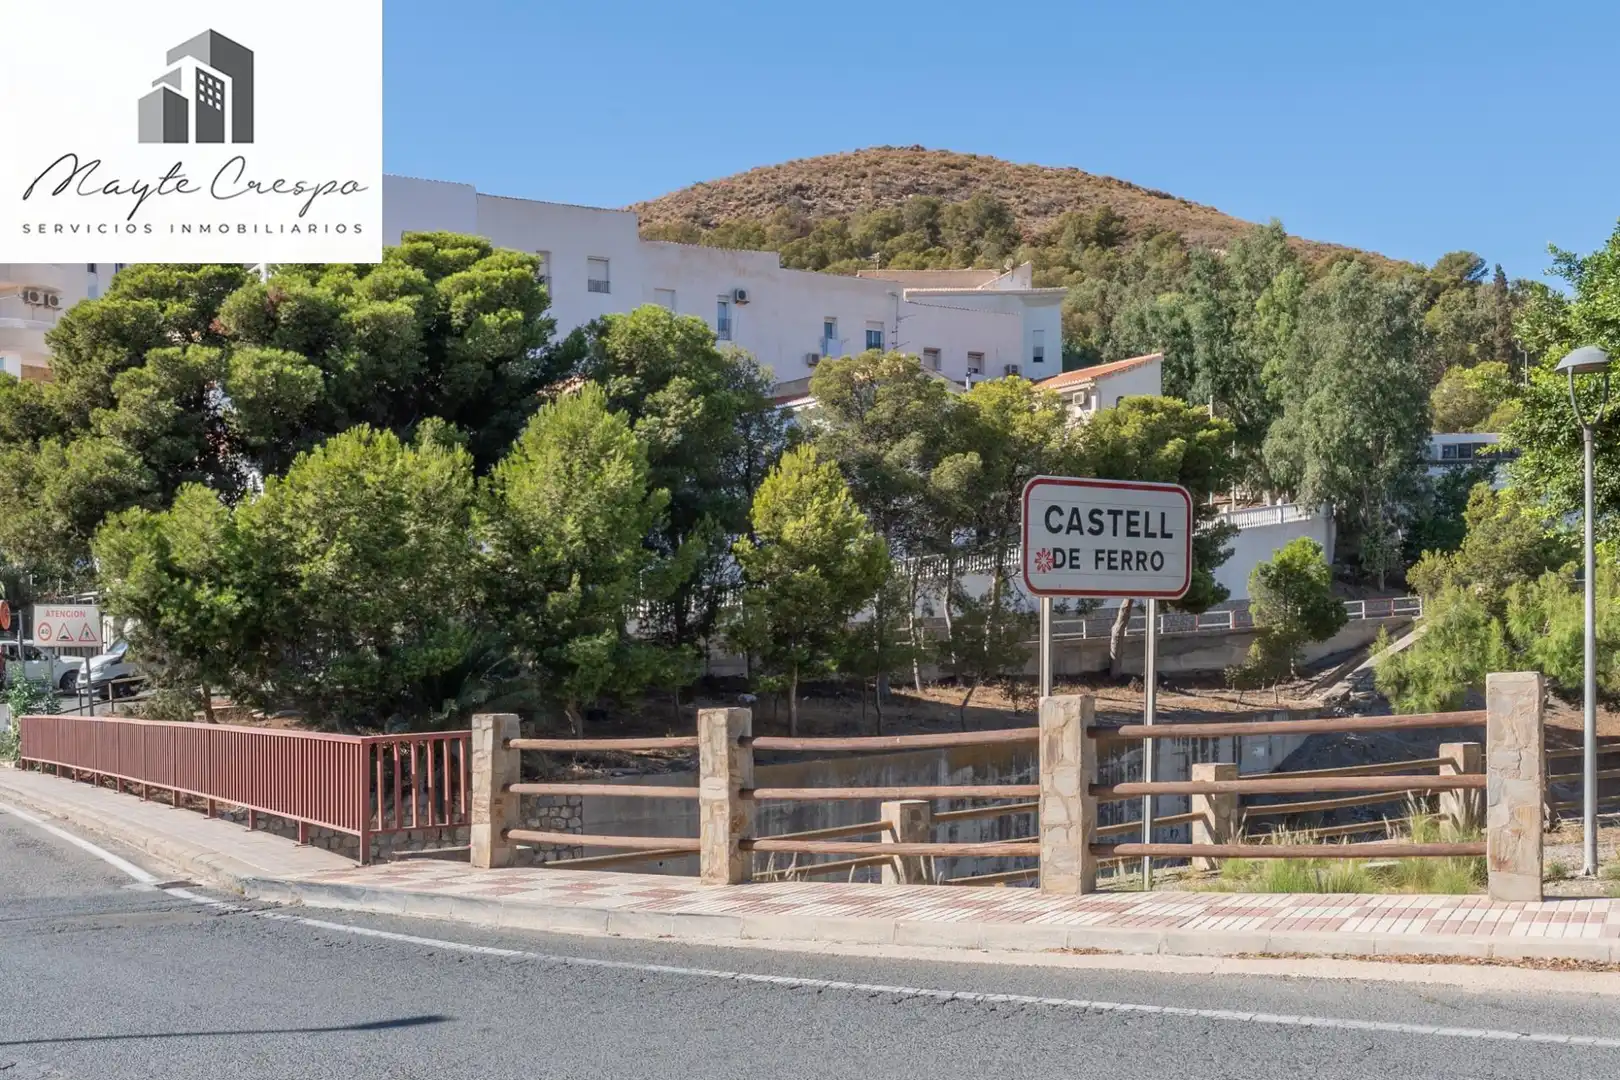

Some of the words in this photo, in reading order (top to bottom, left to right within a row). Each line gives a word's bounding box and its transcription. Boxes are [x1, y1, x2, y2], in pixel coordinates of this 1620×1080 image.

[1044, 504, 1174, 539] CASTELL
[1052, 547, 1081, 570] DE
[1094, 548, 1165, 572] FERRO
[44, 609, 87, 618] ATENCION
